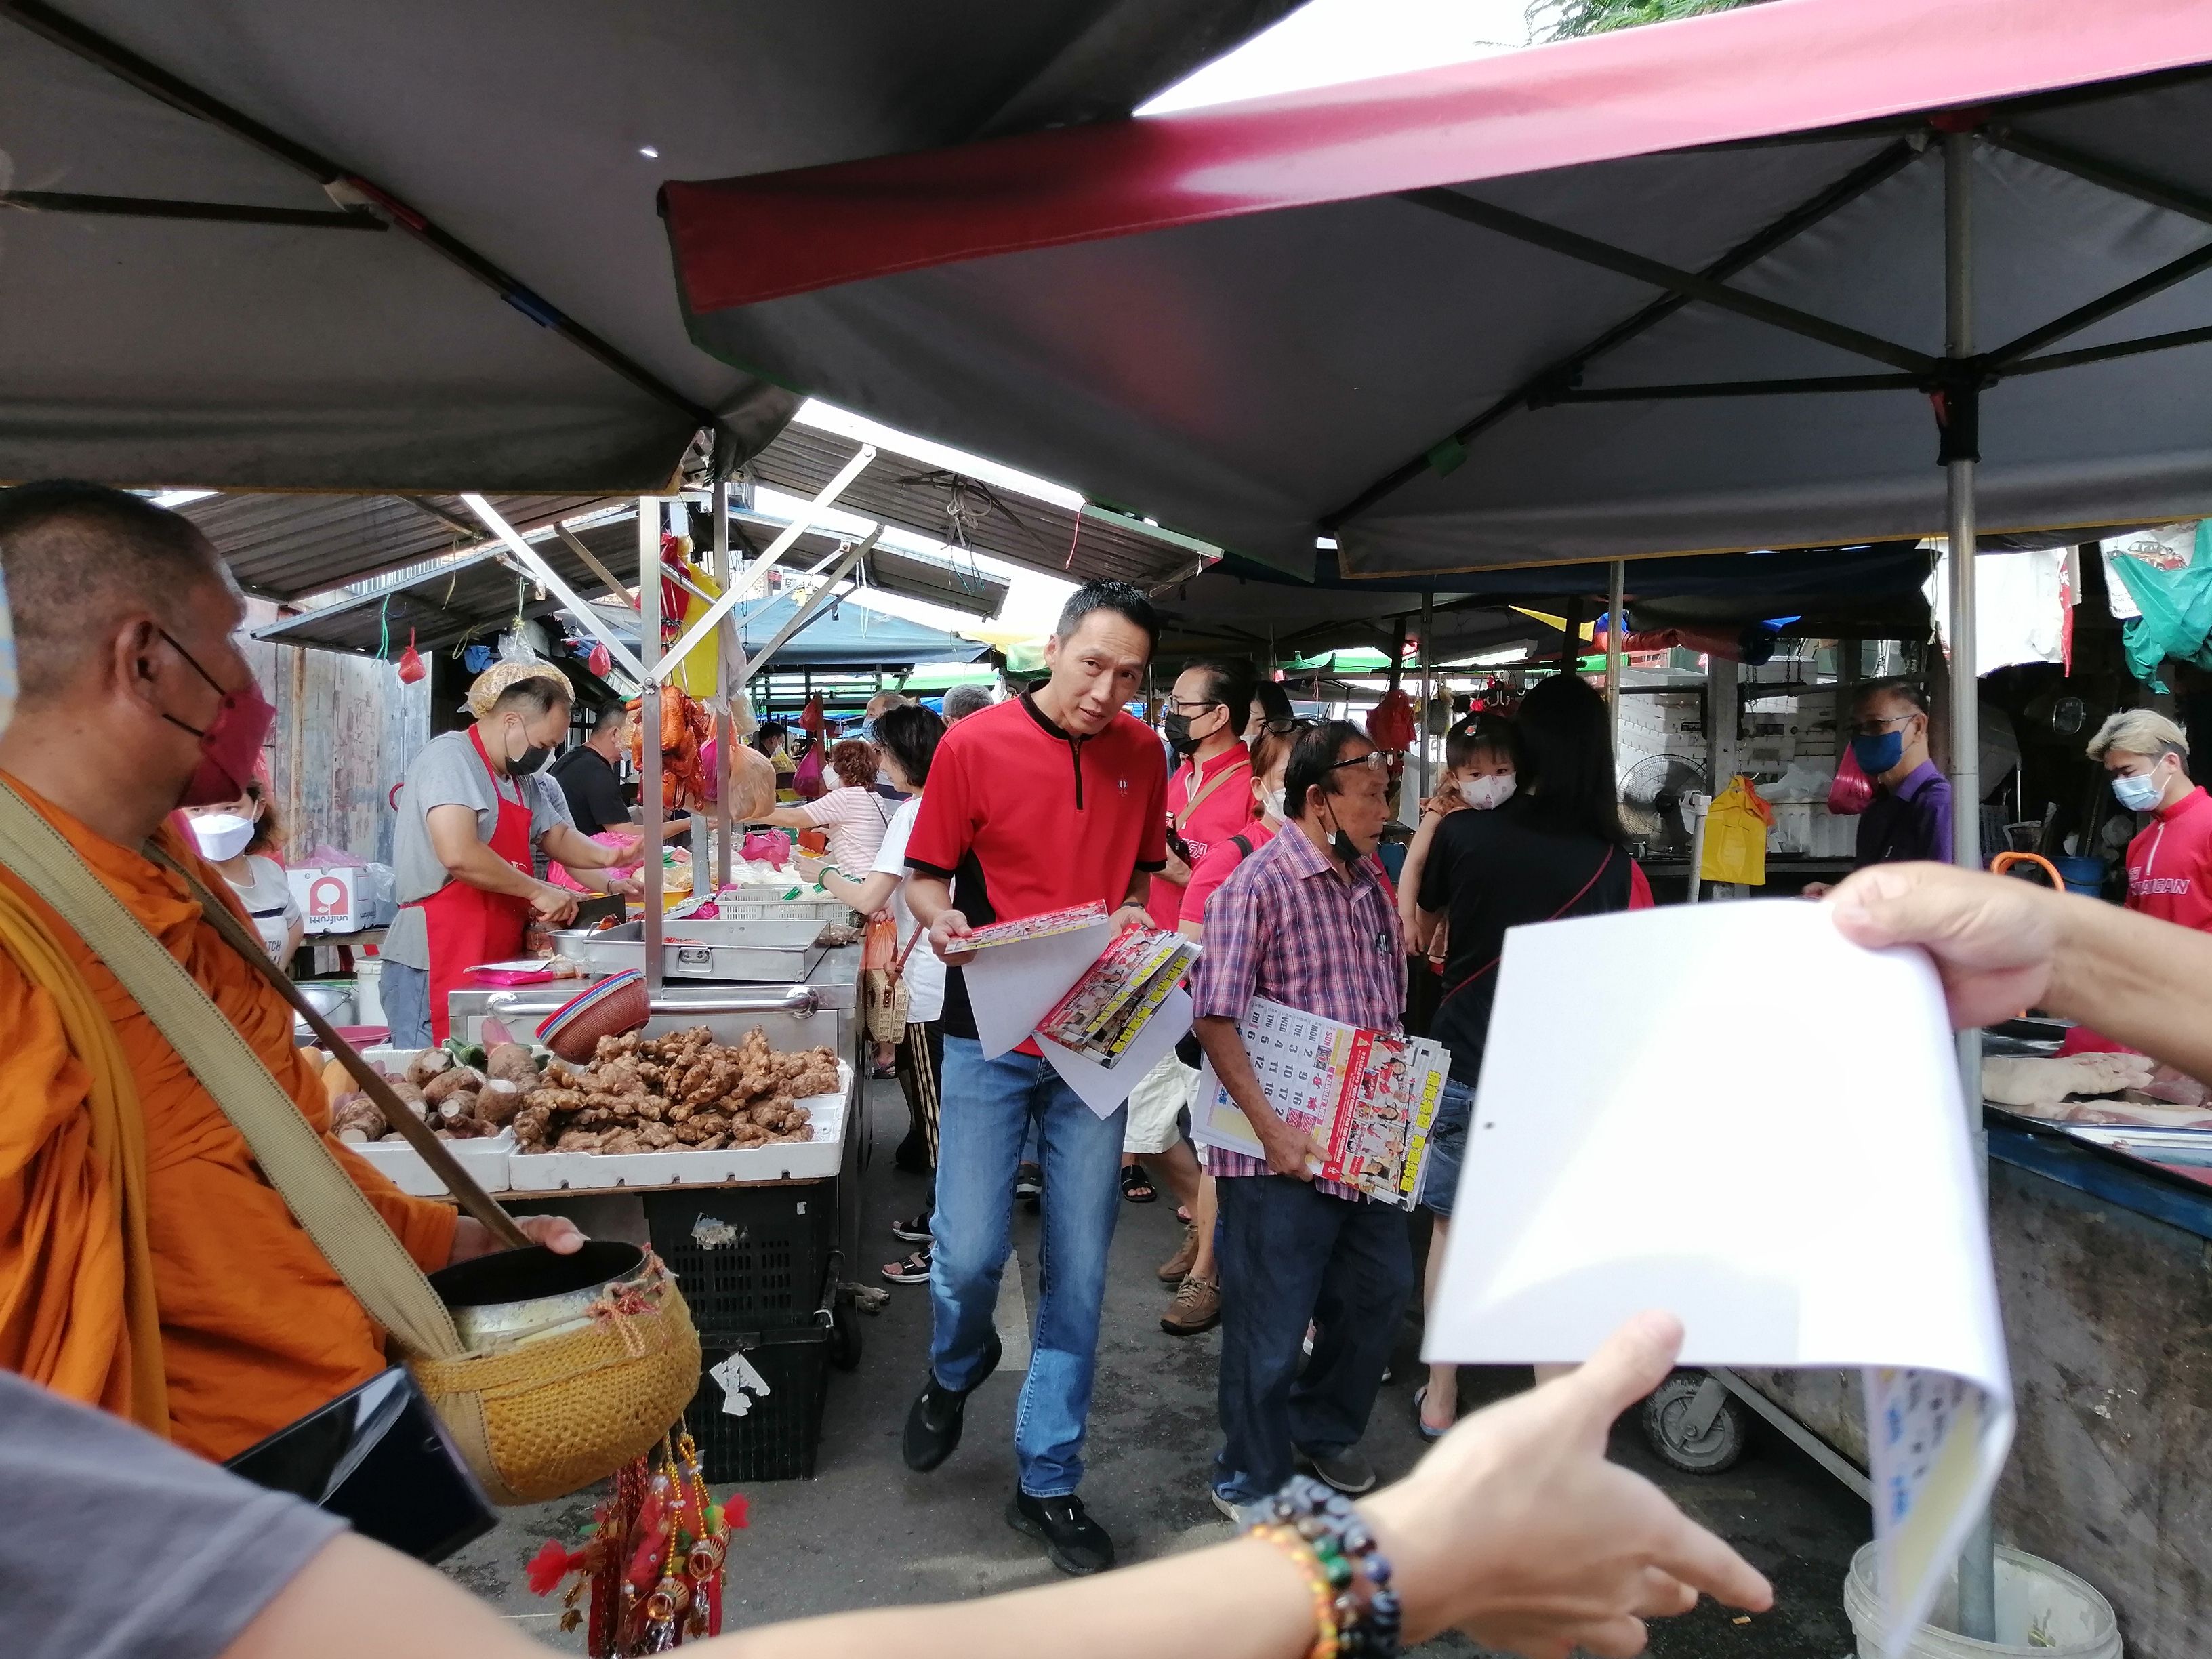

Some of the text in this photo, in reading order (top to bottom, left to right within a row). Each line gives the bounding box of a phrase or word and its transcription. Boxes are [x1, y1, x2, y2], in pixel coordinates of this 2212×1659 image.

[310, 915, 348, 924] unifrutti
[265, 940, 281, 951] TCH
[1252, 1012, 1260, 1024] FRI
[1265, 1014, 1274, 1028] THU
[1279, 1017, 1289, 1033] WED
[1293, 1024, 1303, 1038] TUE
[1247, 1030, 1256, 1040] 6
[1261, 1035, 1270, 1044] 5
[1308, 1025, 1319, 1042] MON
[1324, 1031, 1333, 1046] SUN
[1274, 1040, 1284, 1049] 4
[1289, 1044, 1298, 1054] 3
[1303, 1048, 1313, 1058] 2
[1254, 1055, 1265, 1069] 12
[1269, 1061, 1279, 1073] 11
[1284, 1064, 1294, 1079] 10
[1298, 1071, 1308, 1080] 9
[1264, 1082, 1274, 1097] 18
[1279, 1088, 1288, 1101] 17
[1322, 1077, 1333, 1103] JANUARY
[1293, 1091, 1303, 1106] 16
